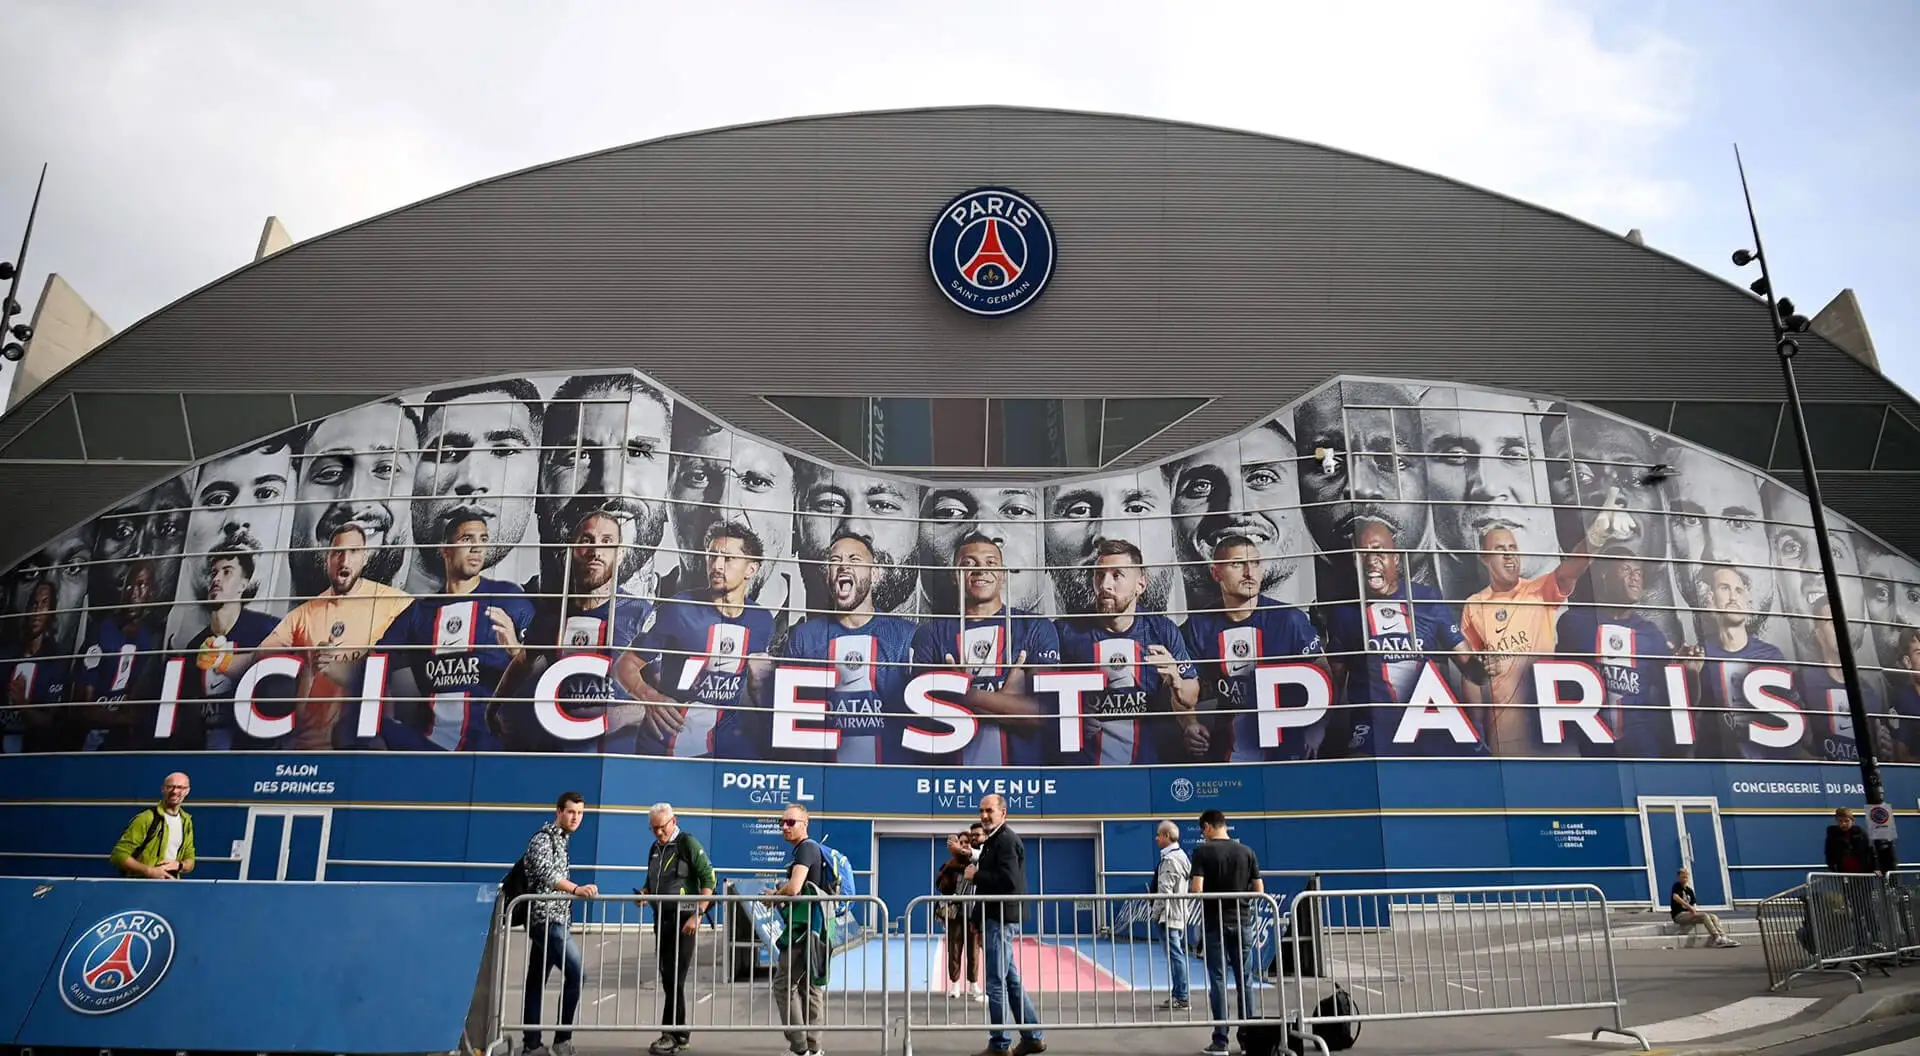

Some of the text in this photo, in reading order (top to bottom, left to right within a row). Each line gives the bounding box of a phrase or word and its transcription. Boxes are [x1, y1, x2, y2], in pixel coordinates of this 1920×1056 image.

[951, 197, 1032, 227] PARIS
[426, 656, 480, 679] QATAR
[433, 673, 480, 687] AIRWAYS
[154, 653, 388, 738] ICI
[1255, 659, 1805, 748] PARIS
[835, 717, 886, 728] AIRWAYS
[1824, 738, 1860, 760] QATA
[275, 764, 319, 777] SALON
[253, 781, 335, 794] DES PRINCES
[722, 772, 791, 790] PORTE
[917, 778, 1057, 794] BIENVENUE
[1195, 780, 1243, 788] EXECUTIVE
[1732, 781, 1866, 795] CONCIERGERIE DU PAR
[796, 777, 815, 801] L
[750, 790, 791, 804] GATE
[938, 795, 1035, 809] WELME
[96, 915, 165, 941] PARIS
